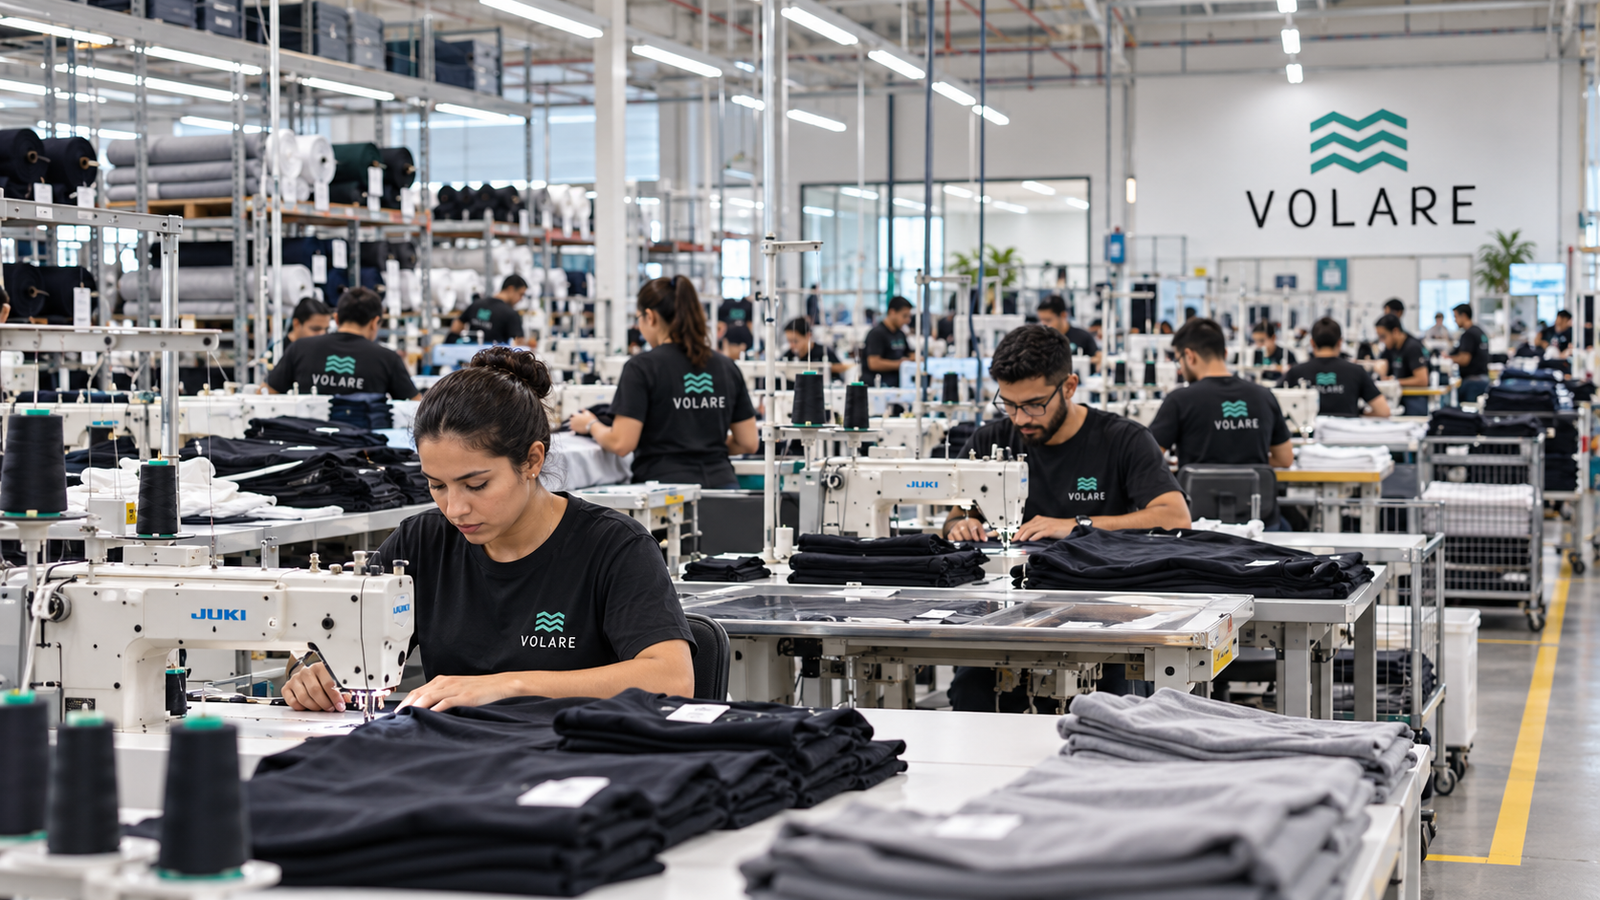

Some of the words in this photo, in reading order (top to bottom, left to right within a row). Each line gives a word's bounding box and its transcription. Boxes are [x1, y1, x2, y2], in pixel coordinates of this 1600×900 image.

[1247, 185, 1476, 228] VOLARE
[311, 374, 365, 389] VOLARE
[673, 396, 726, 410] VOLARE
[1214, 418, 1259, 430] VOLARE
[906, 480, 939, 489] JUKI
[1068, 491, 1105, 501] VOLARE
[191, 608, 247, 622] JUKI
[520, 636, 576, 649] VOLARE
